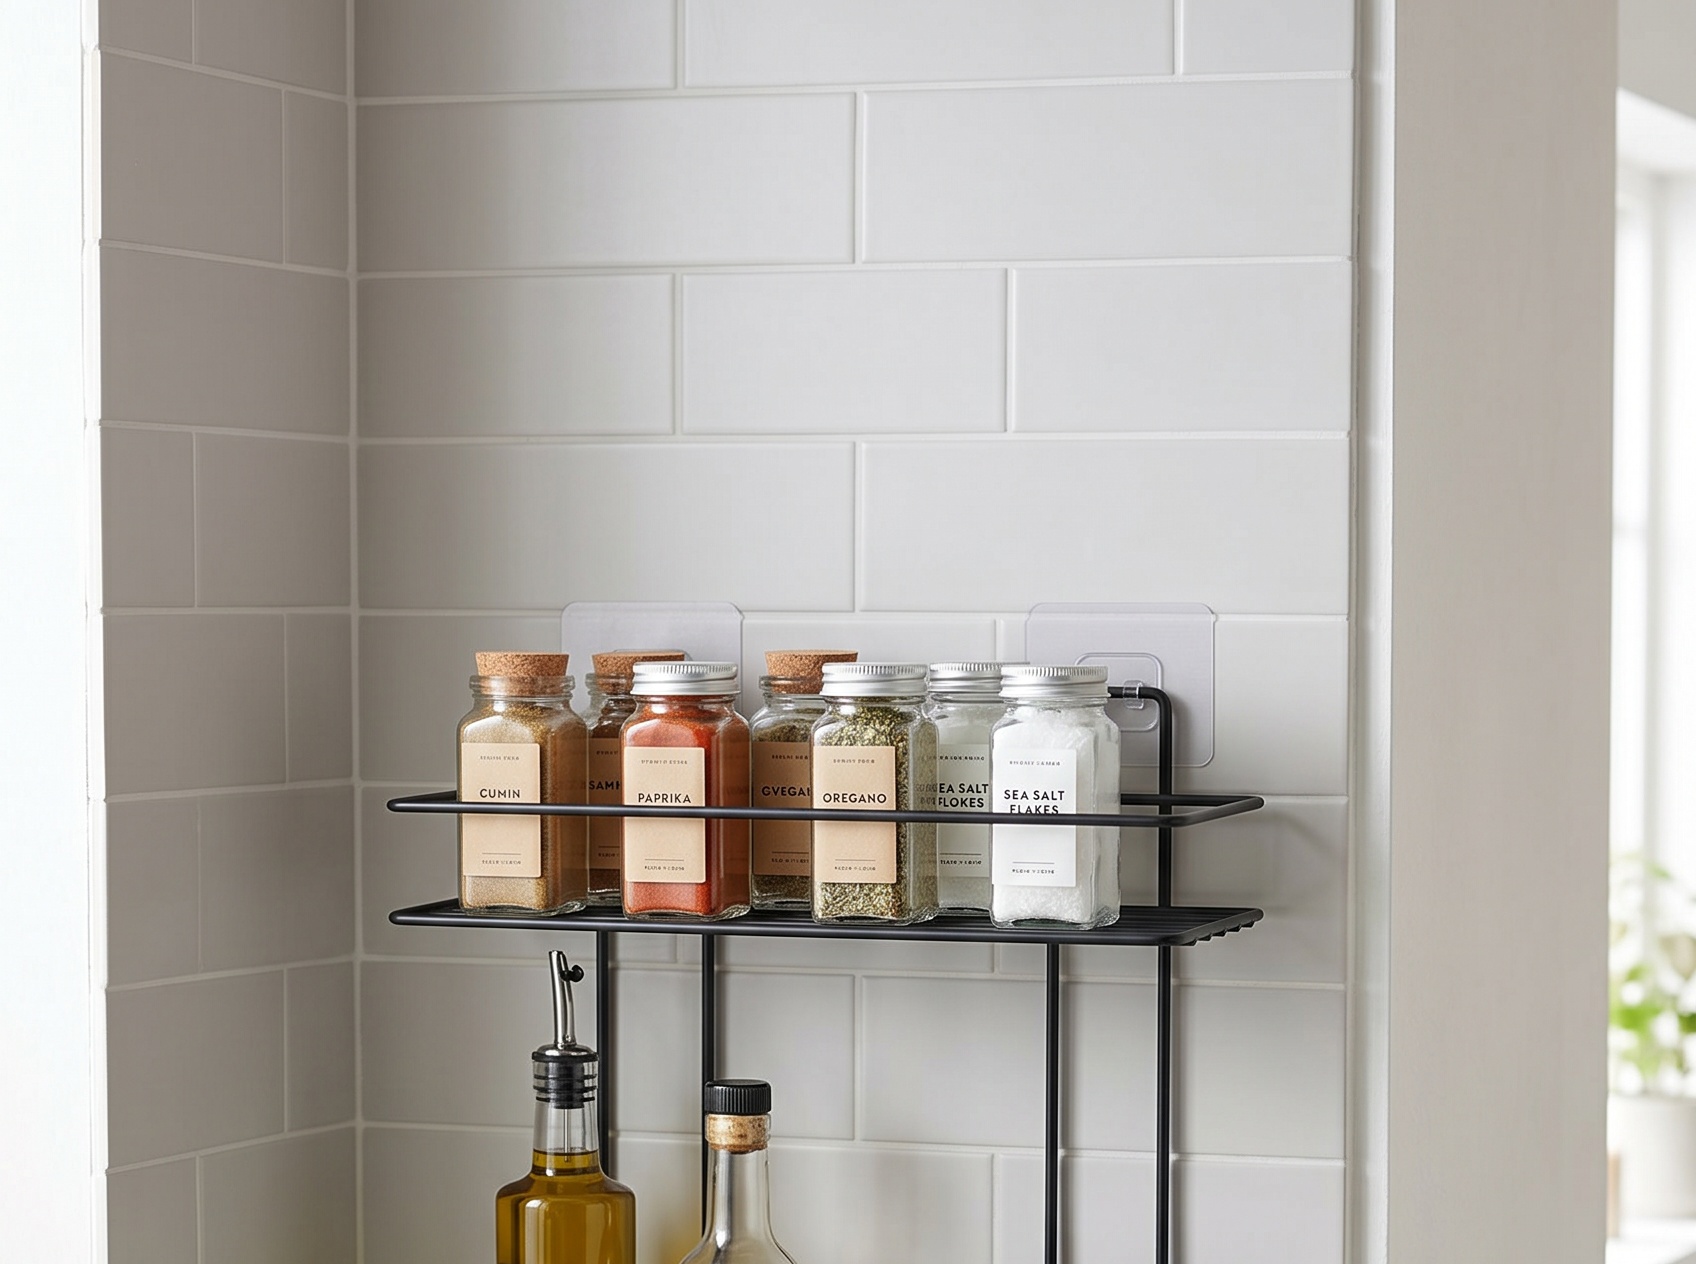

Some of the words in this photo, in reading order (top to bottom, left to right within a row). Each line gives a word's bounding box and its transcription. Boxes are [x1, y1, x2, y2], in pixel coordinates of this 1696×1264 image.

[479, 788, 521, 799] CUMIN
[958, 783, 989, 794] SALT
[637, 792, 692, 804] PAPRIKA
[822, 793, 887, 804] OREGANO
[1003, 789, 1029, 800] SEA
[1033, 790, 1065, 801] SALT
[938, 797, 984, 808] FLOKES
[1009, 804, 1059, 814] FLAKES
